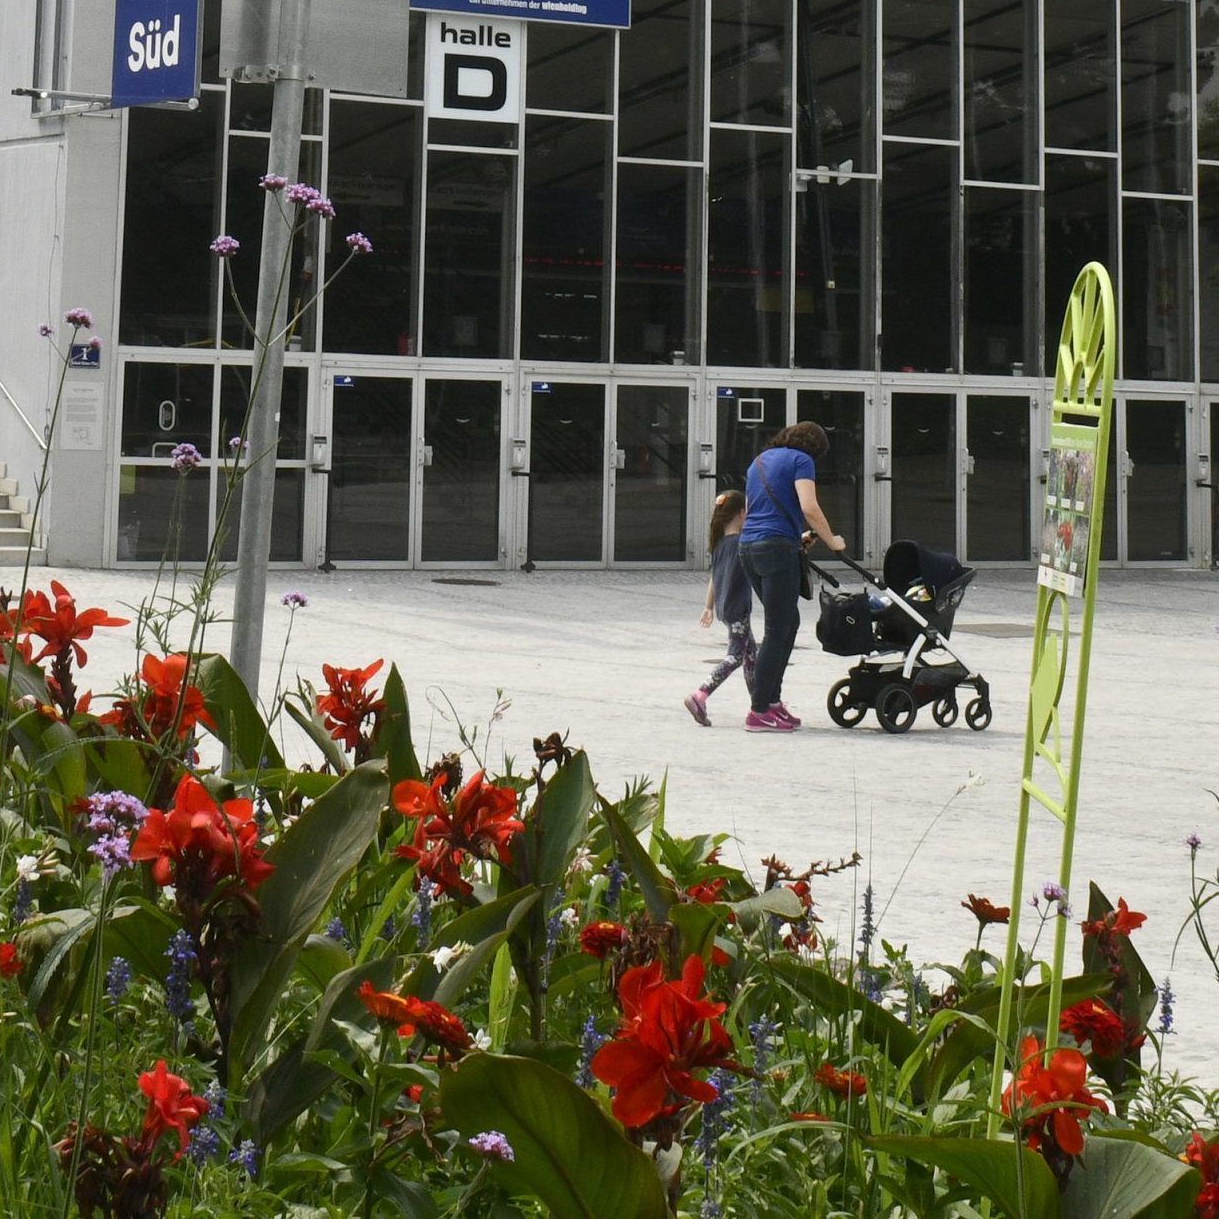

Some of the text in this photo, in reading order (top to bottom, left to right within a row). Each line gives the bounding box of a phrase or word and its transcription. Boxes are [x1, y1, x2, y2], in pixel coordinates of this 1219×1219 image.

[529, 0, 541, 9] der
[128, 14, 180, 73] Süd
[440, 21, 511, 48] halle
[443, 53, 508, 112] D
[81, 348, 89, 360] 1
